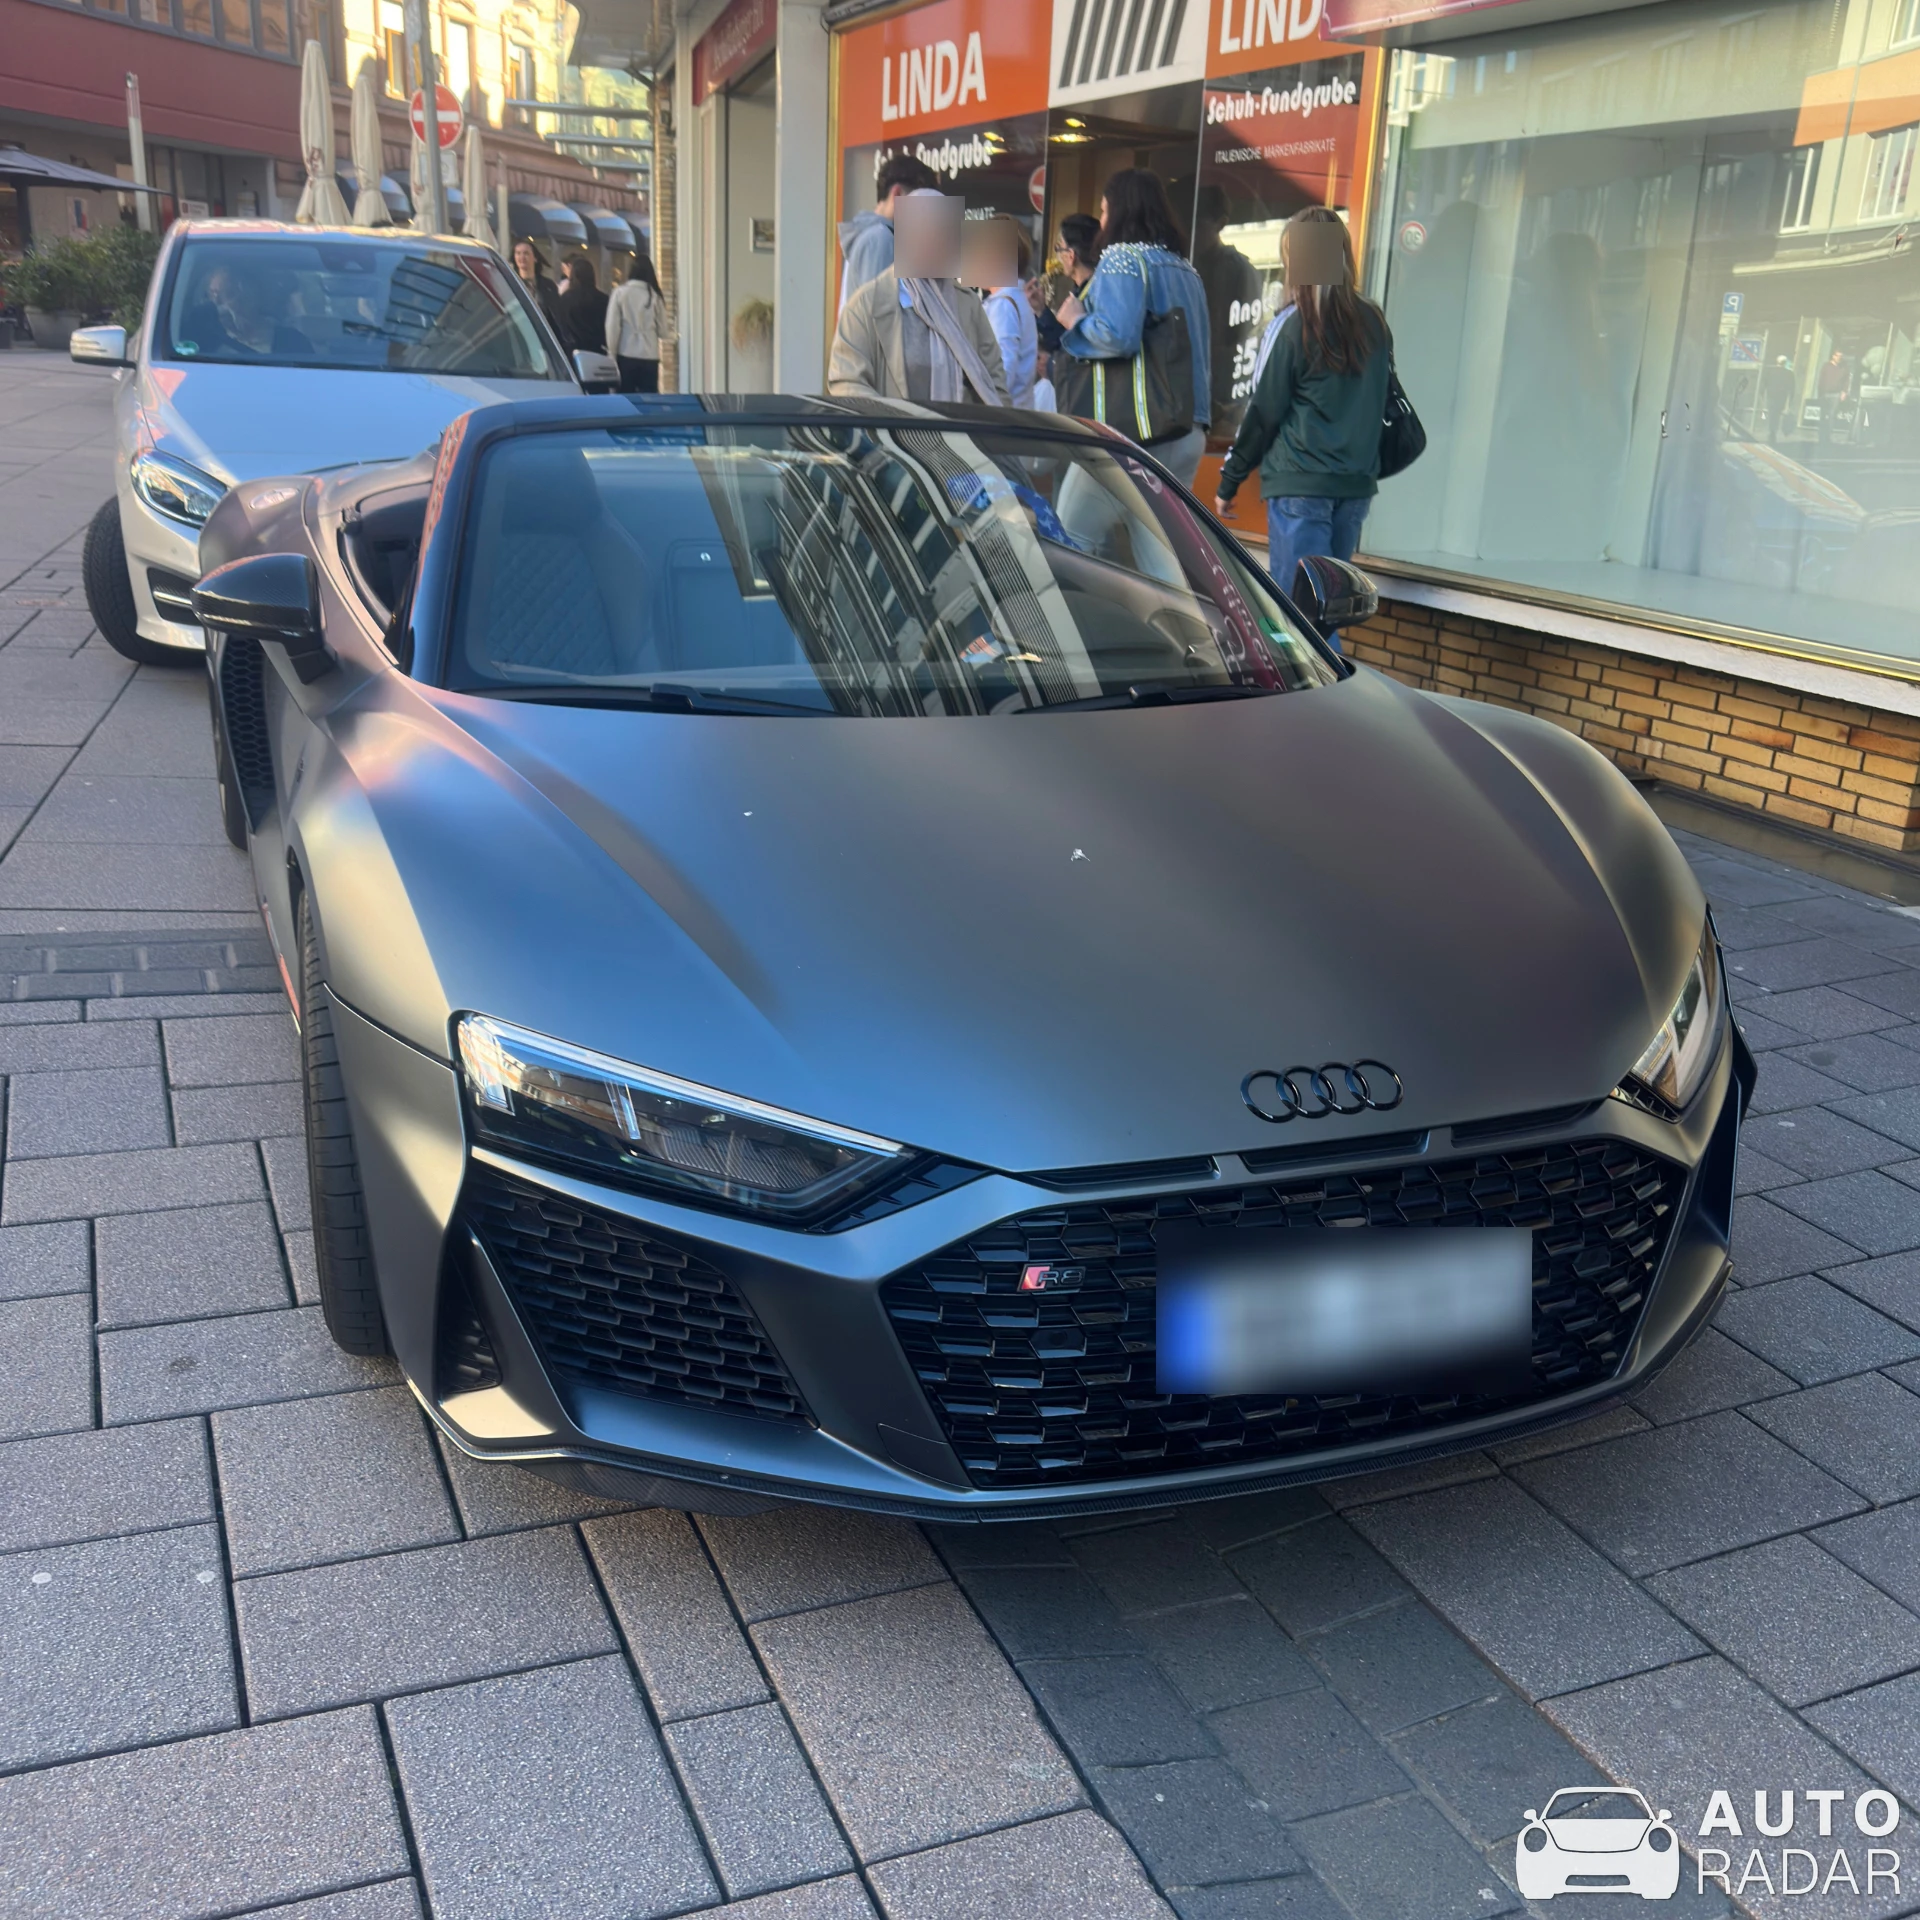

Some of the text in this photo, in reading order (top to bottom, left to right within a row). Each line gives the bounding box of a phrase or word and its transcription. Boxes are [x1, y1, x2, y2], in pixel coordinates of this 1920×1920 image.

[1219, 0, 1322, 55] LIND
[882, 31, 987, 122] LINDA
[1206, 76, 1357, 125] Schuh-Fundgrube
[1215, 147, 1262, 163] ITALIENISCHE
